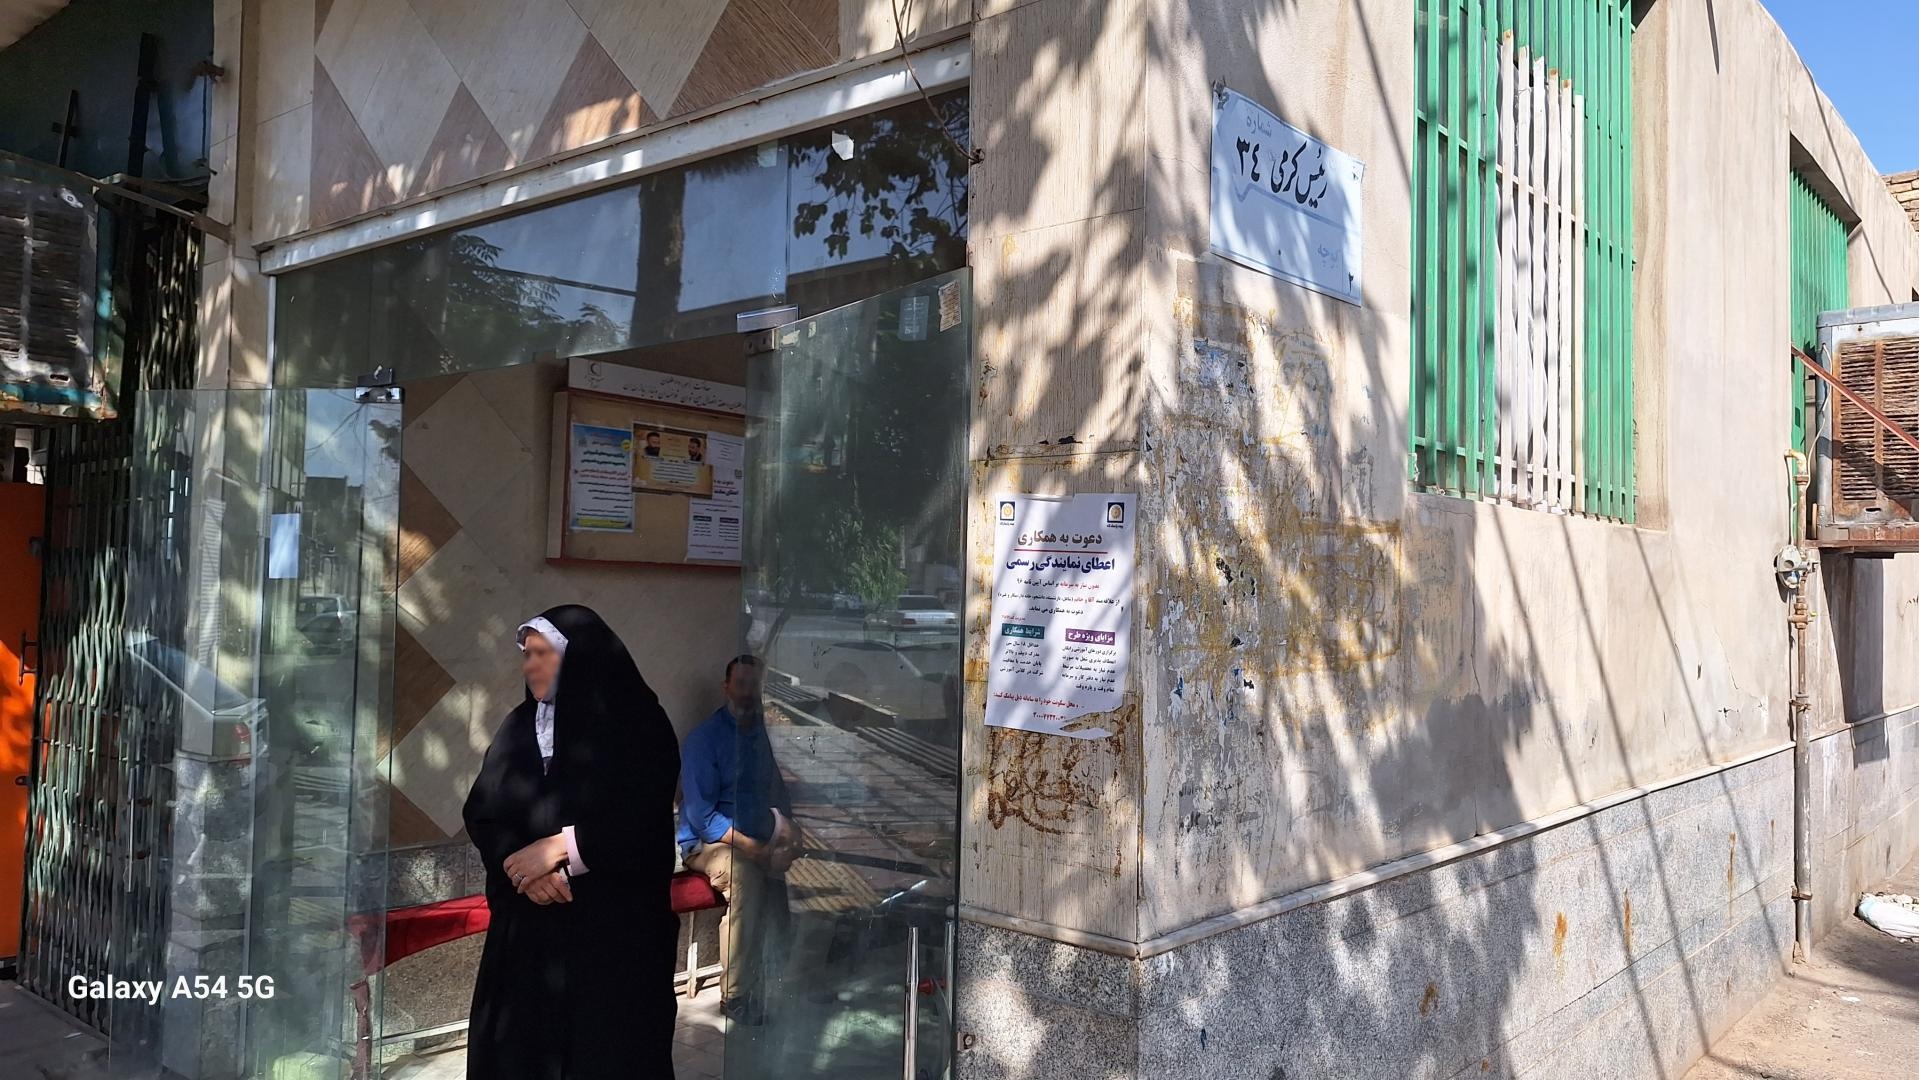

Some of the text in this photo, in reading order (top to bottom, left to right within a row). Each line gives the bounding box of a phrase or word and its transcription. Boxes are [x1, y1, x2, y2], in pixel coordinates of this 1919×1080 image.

[1017, 529, 1103, 548] دعوت به همکاری
[1006, 554, 1115, 573] اعطای نمایندگی رسمی
[1048, 606, 1065, 615] همکاری
[1071, 606, 1084, 615] دعوت
[1004, 625, 1024, 635] همکاری
[1068, 631, 1114, 643] مزایای ویژه طرح
